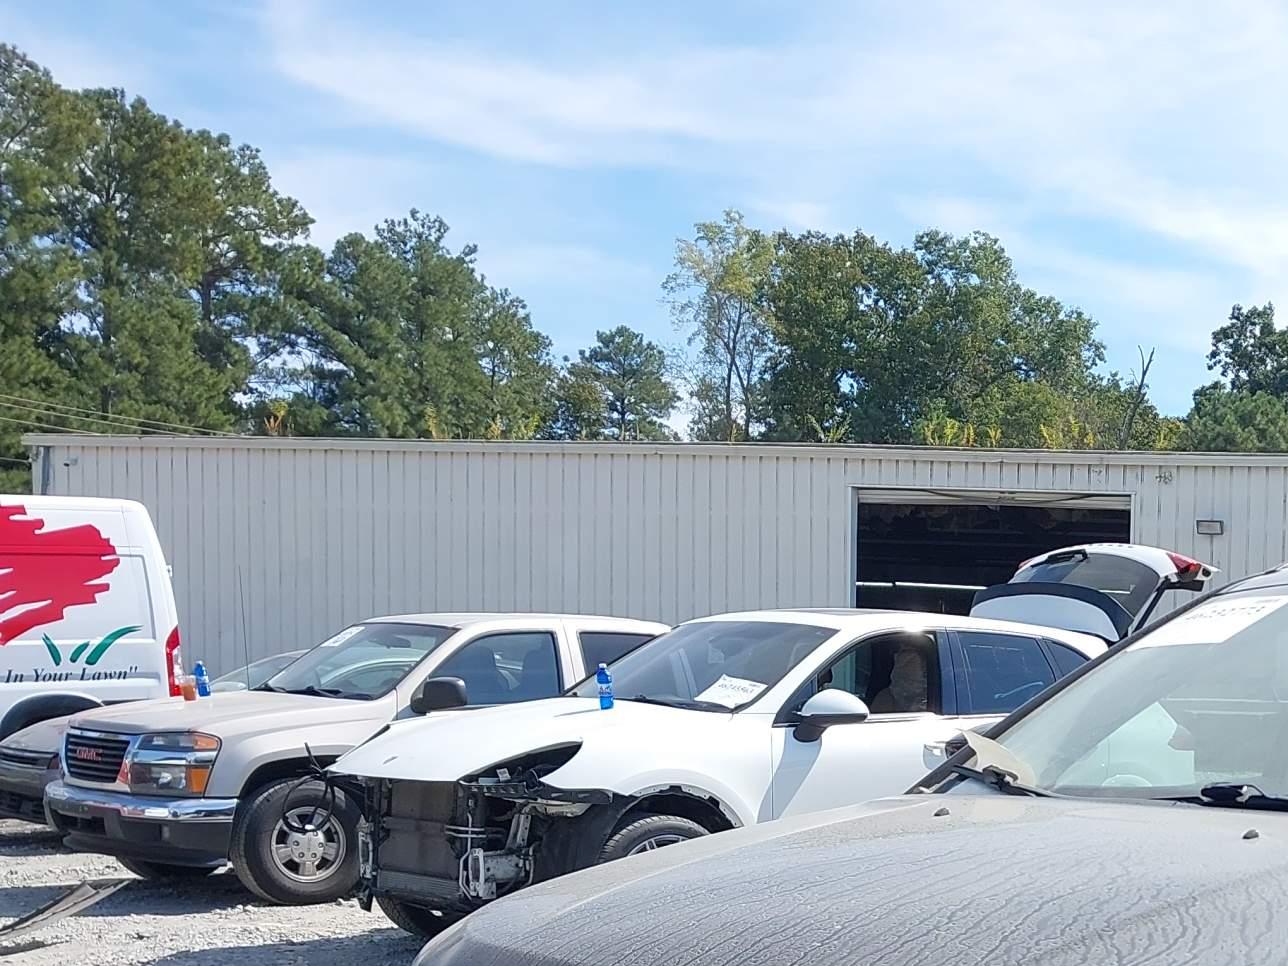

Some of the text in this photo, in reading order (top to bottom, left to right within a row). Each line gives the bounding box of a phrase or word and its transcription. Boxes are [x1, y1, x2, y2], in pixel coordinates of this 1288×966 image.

[4, 669, 24, 683] In
[33, 668, 73, 682] Your
[76, 746, 103, 760] GMC
